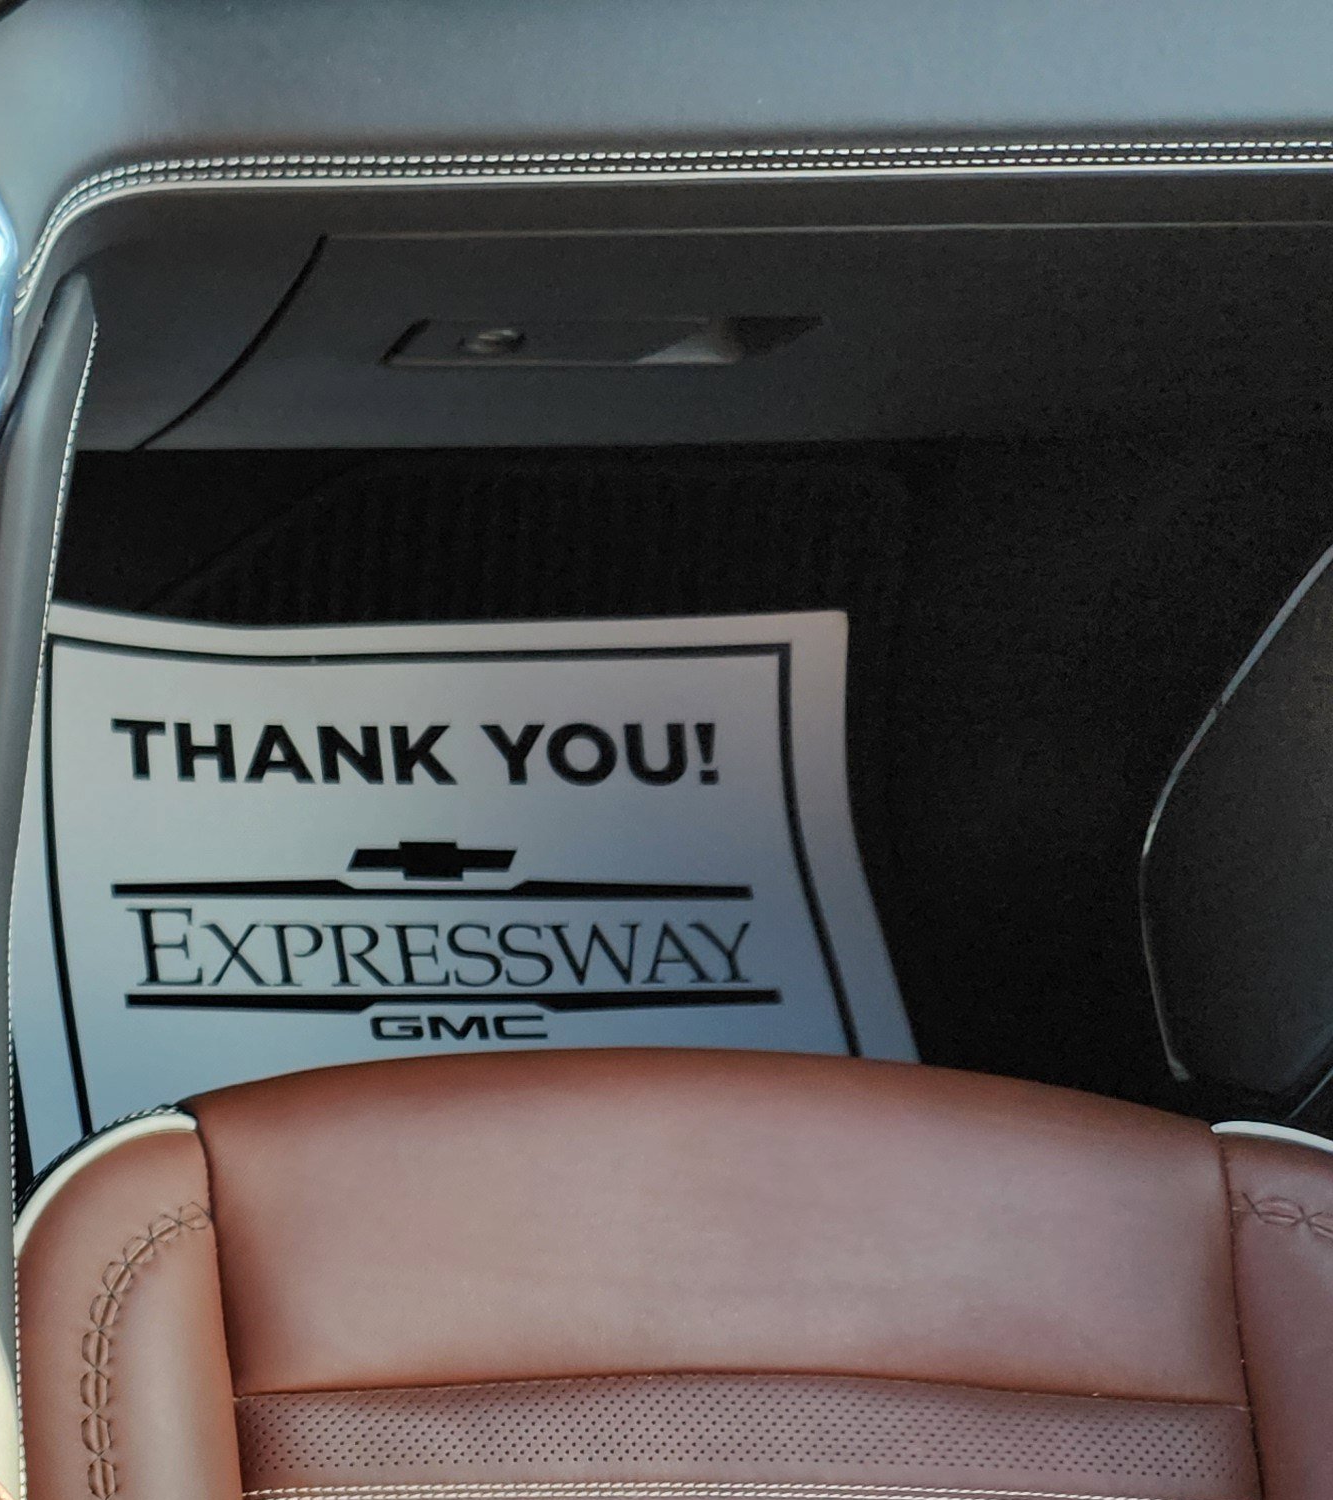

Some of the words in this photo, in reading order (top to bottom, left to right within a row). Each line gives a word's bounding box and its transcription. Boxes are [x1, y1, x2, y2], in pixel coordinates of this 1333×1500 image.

[111, 718, 457, 786] THANK
[481, 721, 720, 786] YOU!
[370, 1013, 550, 1043] GMC
